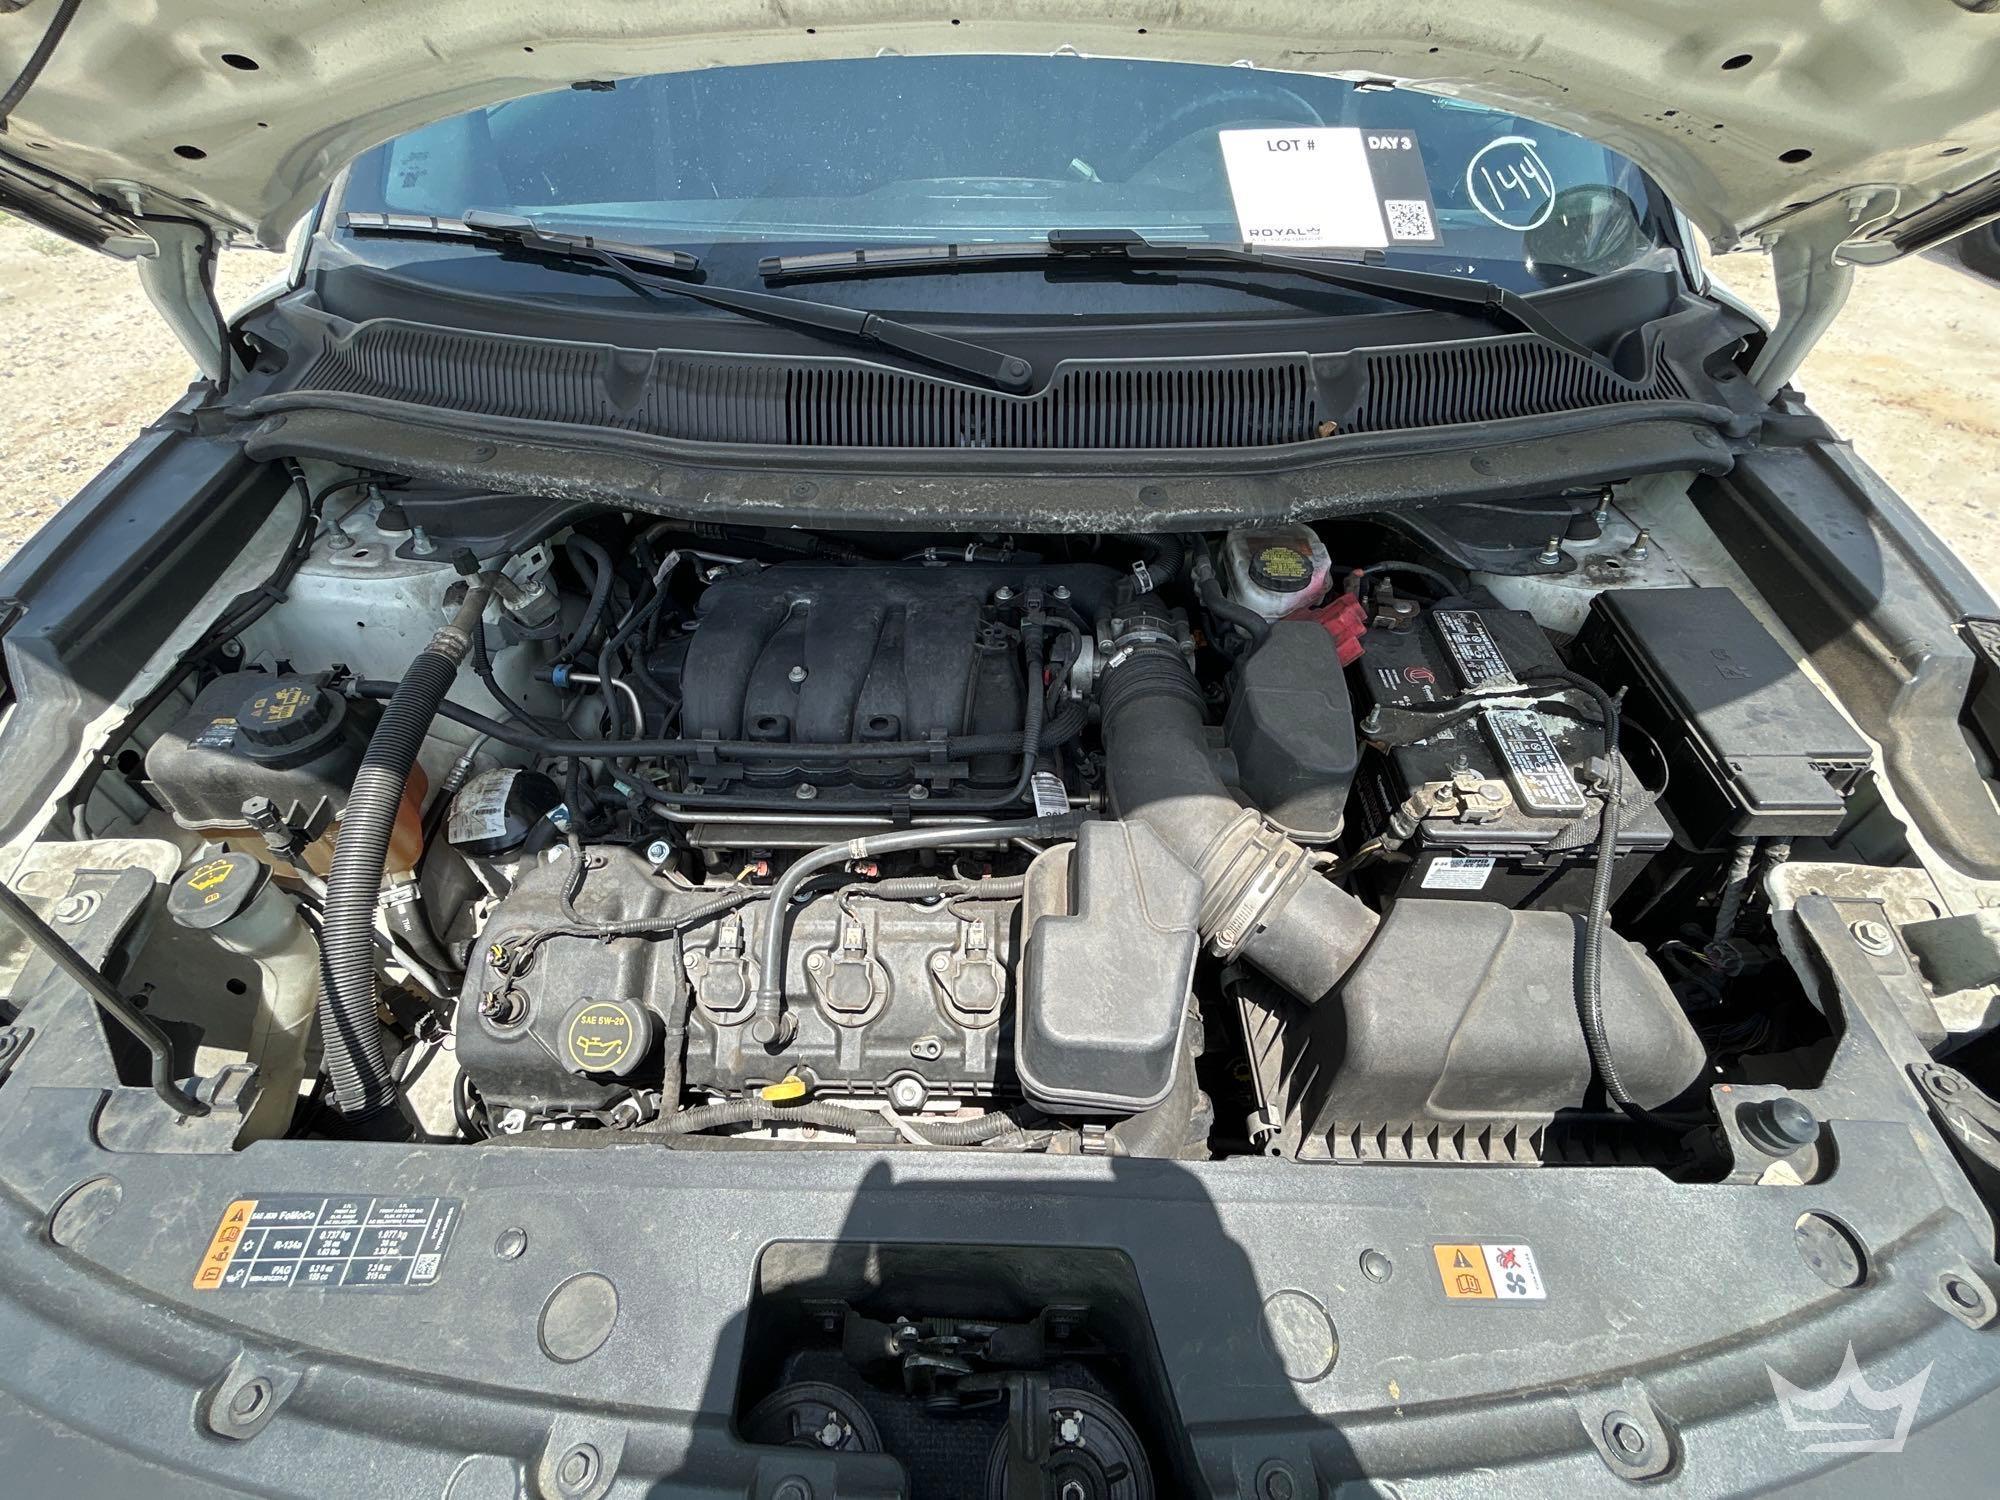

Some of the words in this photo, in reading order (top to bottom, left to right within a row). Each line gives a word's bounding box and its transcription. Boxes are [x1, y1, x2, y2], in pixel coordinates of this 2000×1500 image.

[1267, 139, 1301, 152] LOT
[1307, 139, 1316, 151] #
[1368, 136, 1399, 150] DAY
[1400, 136, 1412, 151] 3
[1481, 155, 1551, 211] 144
[1249, 227, 1306, 237] ROYAL
[581, 1015, 597, 1025] SAE
[598, 1016, 625, 1026] 5W-20
[279, 1211, 315, 1220] FoMoCo
[339, 1230, 351, 1241] kg
[273, 1241, 303, 1250] R-134a
[271, 1265, 292, 1275] PAG
